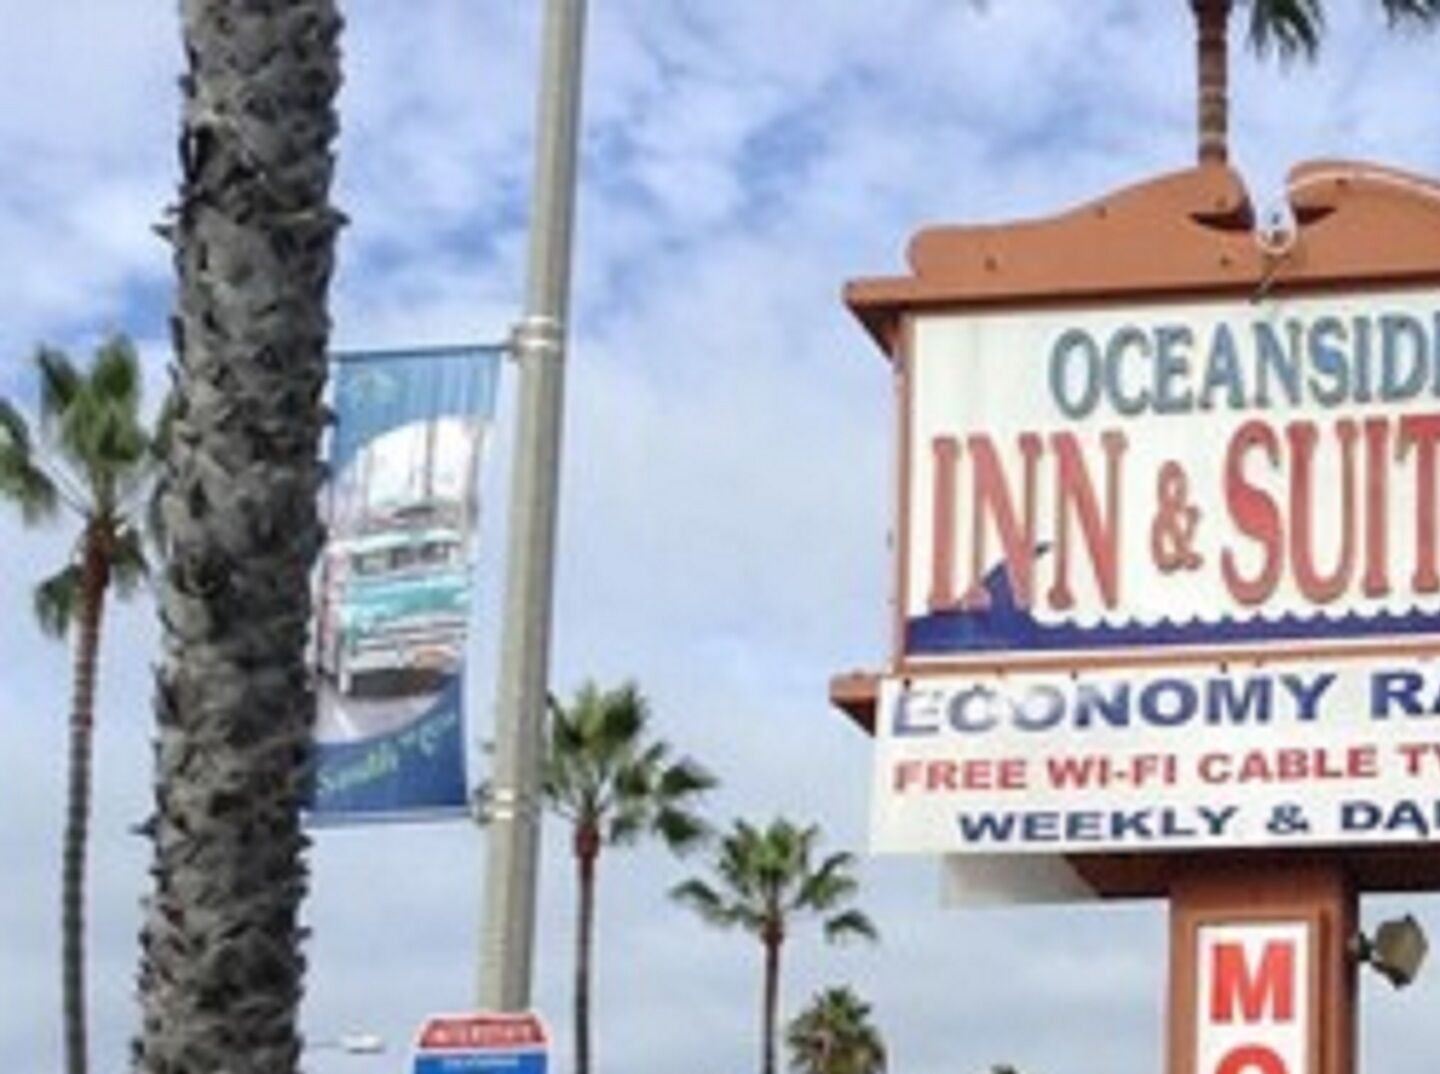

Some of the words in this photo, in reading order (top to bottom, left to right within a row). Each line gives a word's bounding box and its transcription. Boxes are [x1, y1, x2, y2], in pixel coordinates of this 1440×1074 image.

[926, 430, 1128, 611] INN
[1150, 459, 1203, 574] &
[892, 672, 1337, 738] ECONOMY
[893, 758, 1029, 792] FREE
[1046, 753, 1179, 790] WI-FI
[1197, 745, 1378, 785] CABLE
[957, 804, 1239, 843] WEEKLY
[1265, 803, 1310, 835] &
